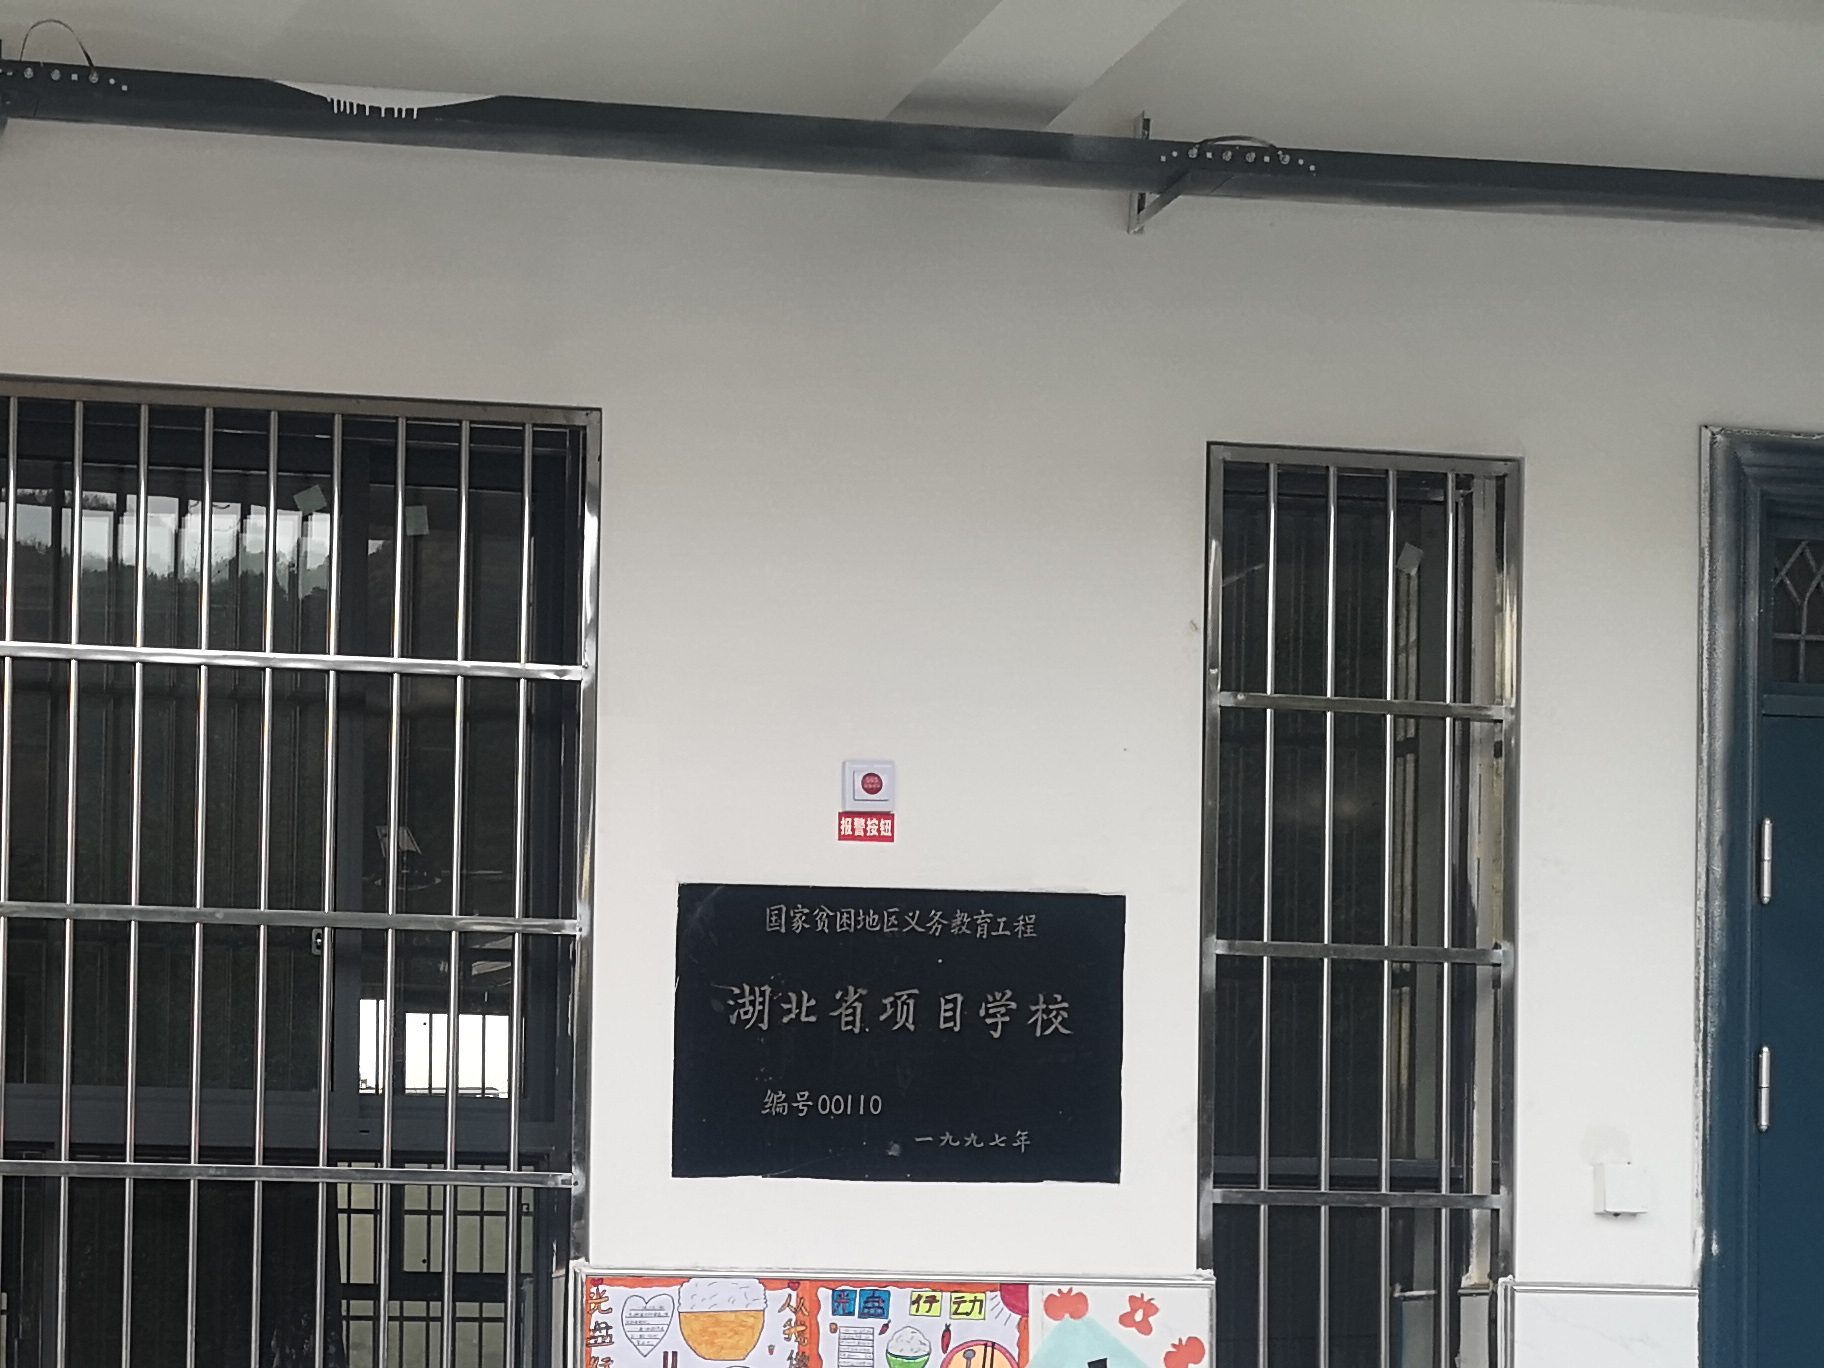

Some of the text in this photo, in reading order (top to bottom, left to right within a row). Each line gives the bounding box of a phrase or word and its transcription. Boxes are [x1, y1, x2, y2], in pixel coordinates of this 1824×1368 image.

[840, 817, 892, 837] 报警按钮
[766, 905, 1038, 939] 国家贫困地区义务教育工程
[727, 984, 1074, 1038] 湖北省项目学校
[761, 1090, 882, 1116] 编号00110
[914, 1130, 1032, 1153] 一九九七年
